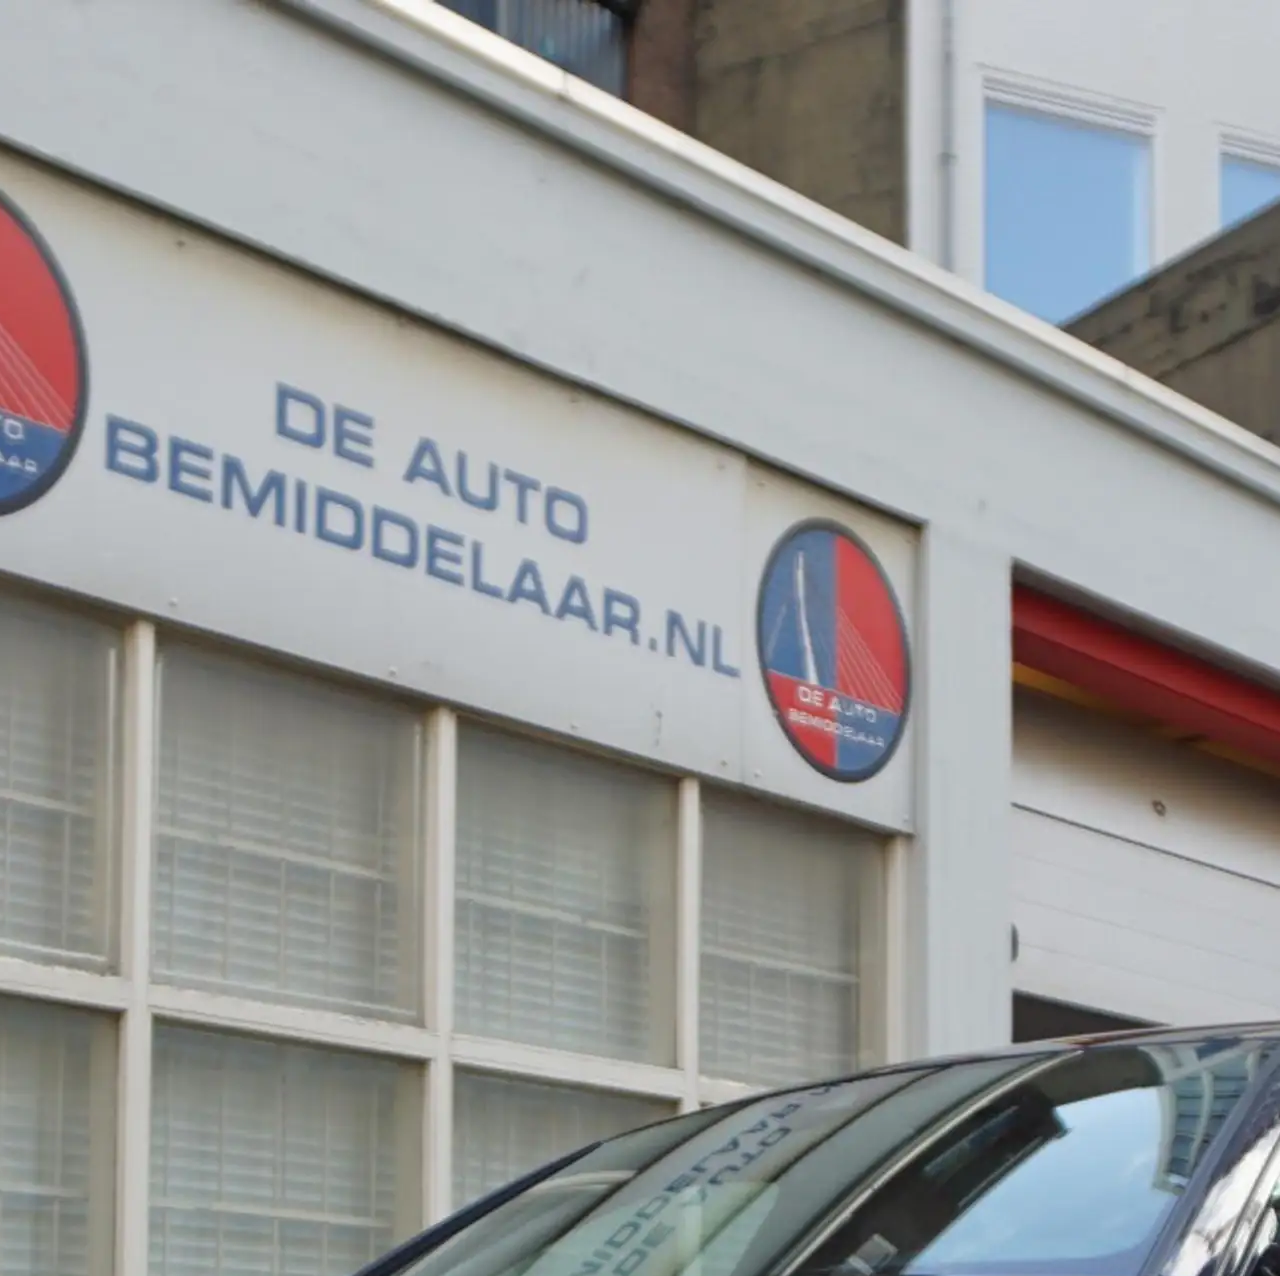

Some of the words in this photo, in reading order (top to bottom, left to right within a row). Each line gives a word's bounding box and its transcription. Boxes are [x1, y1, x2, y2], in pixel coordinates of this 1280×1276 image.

[105, 412, 741, 679] BEMIDDELAAR.NL
[275, 381, 375, 470] DE
[401, 436, 589, 546] AUTO
[798, 686, 824, 707] DE
[829, 696, 876, 723] AUTO
